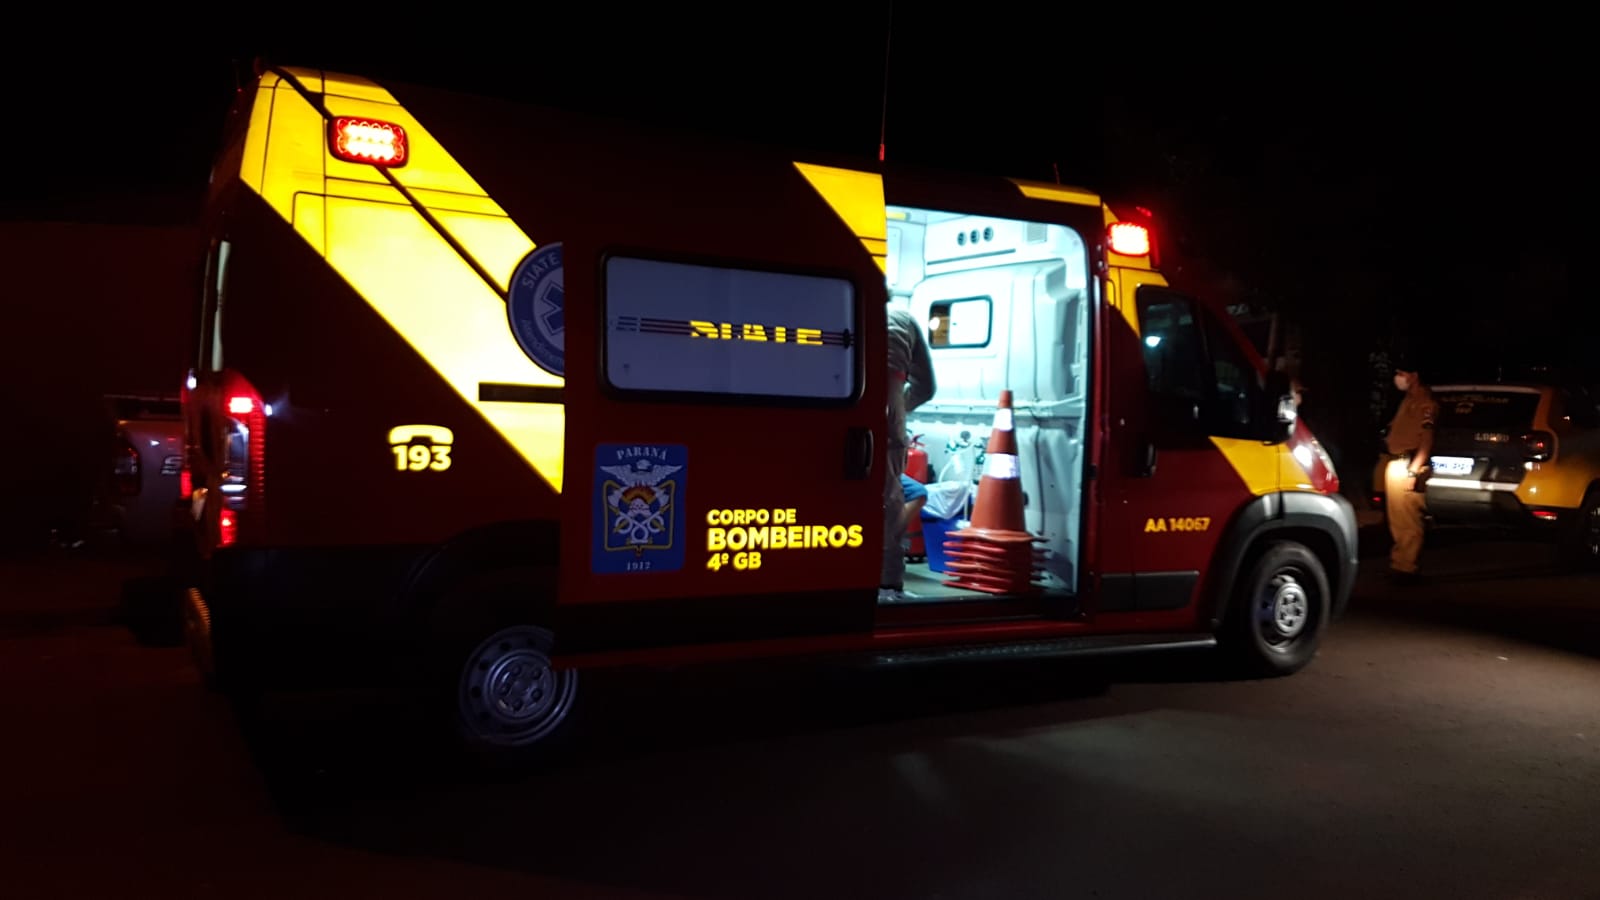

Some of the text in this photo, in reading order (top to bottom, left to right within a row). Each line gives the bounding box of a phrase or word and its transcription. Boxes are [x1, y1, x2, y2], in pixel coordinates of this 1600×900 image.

[522, 251, 560, 288] SIATE
[390, 444, 452, 472] 193
[706, 507, 797, 526] CORPO DE
[1143, 516, 1168, 533] AA
[706, 524, 864, 552] BOMBEIROS
[733, 551, 763, 572] GB
